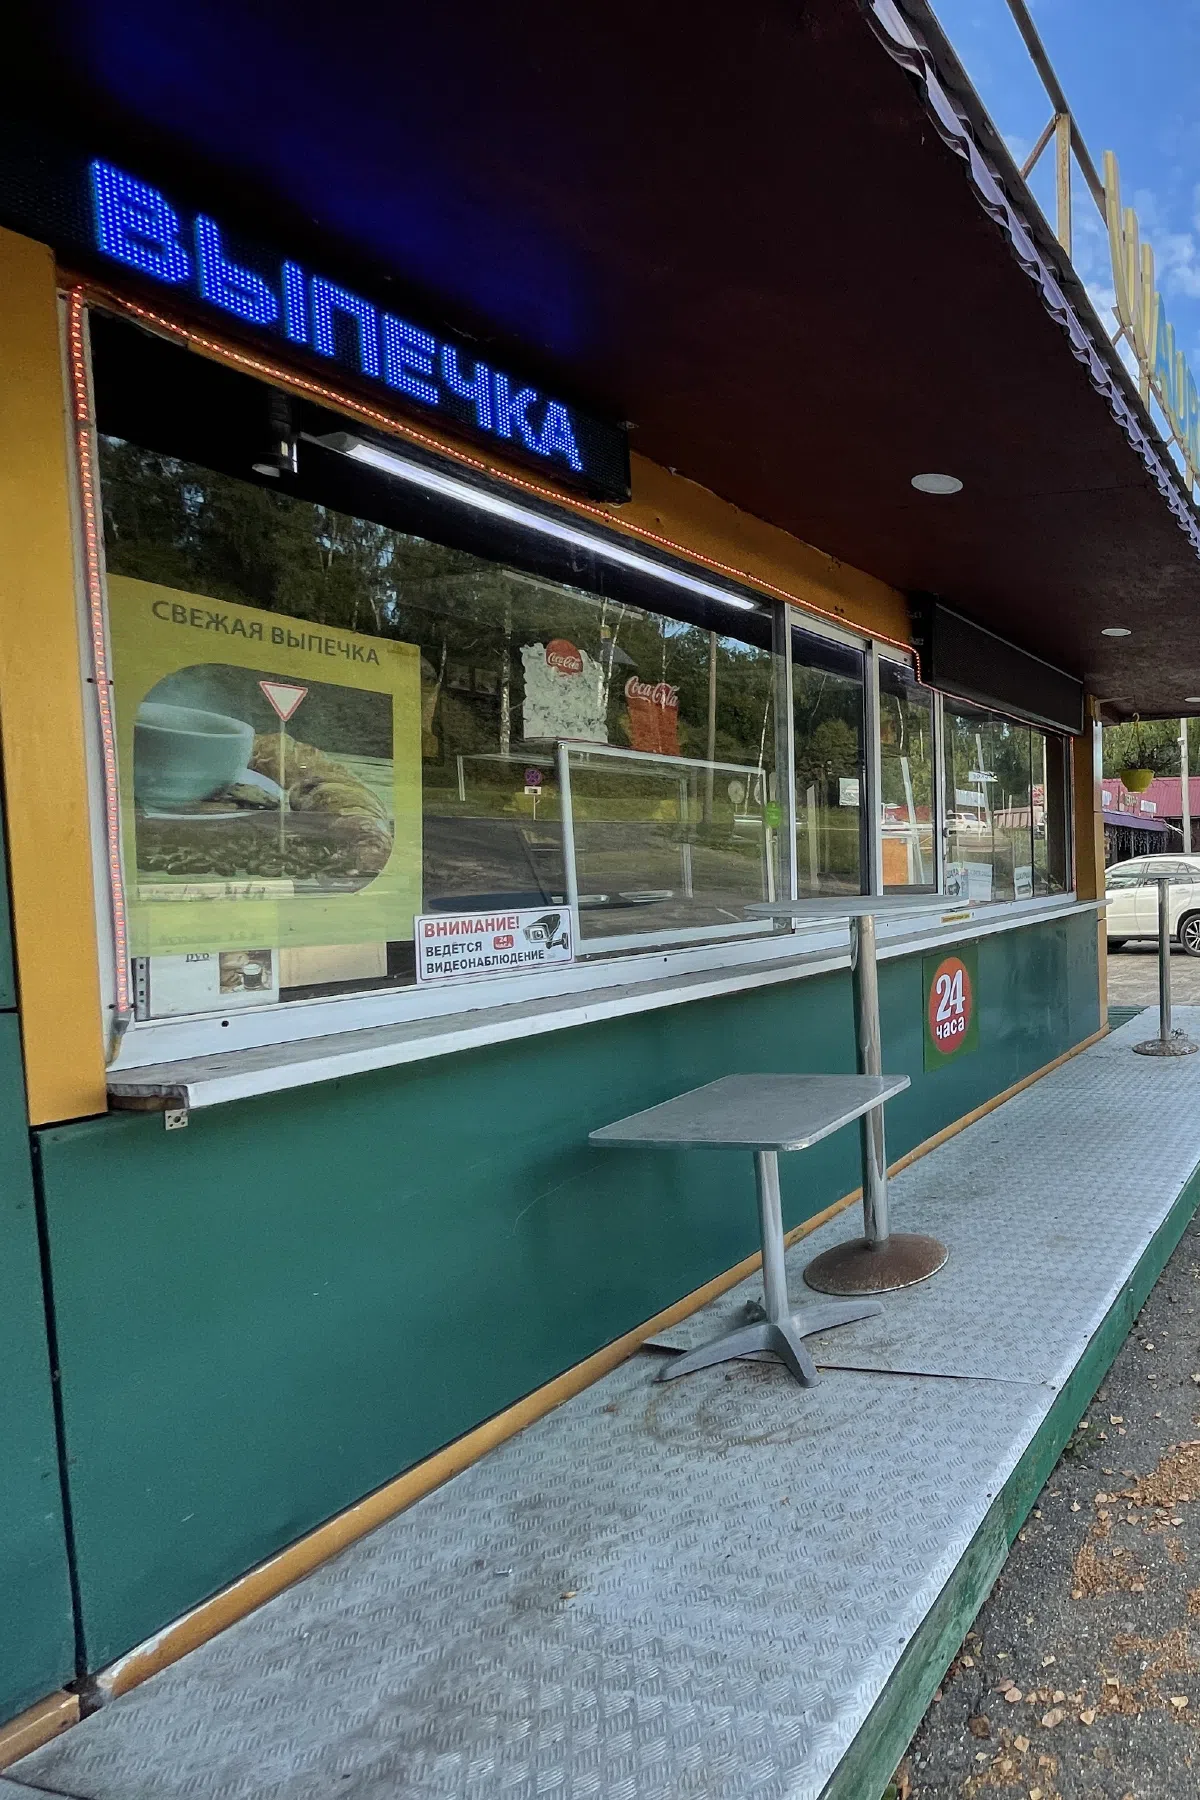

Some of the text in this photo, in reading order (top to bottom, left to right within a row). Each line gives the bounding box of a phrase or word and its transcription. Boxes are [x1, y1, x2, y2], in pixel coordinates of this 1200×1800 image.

[91, 157, 583, 473] ВЫПЕЧКА
[151, 600, 380, 665] СВЕЖАЯ ВЫПЕЧКА
[624, 675, 681, 707] Coca-Cola
[424, 916, 520, 938] ВНИМАНИЕ!
[426, 950, 545, 974] ВИДЕОНАБЛЮДЕНИЕ
[936, 969, 965, 1022] 24
[936, 1016, 965, 1039] часа
